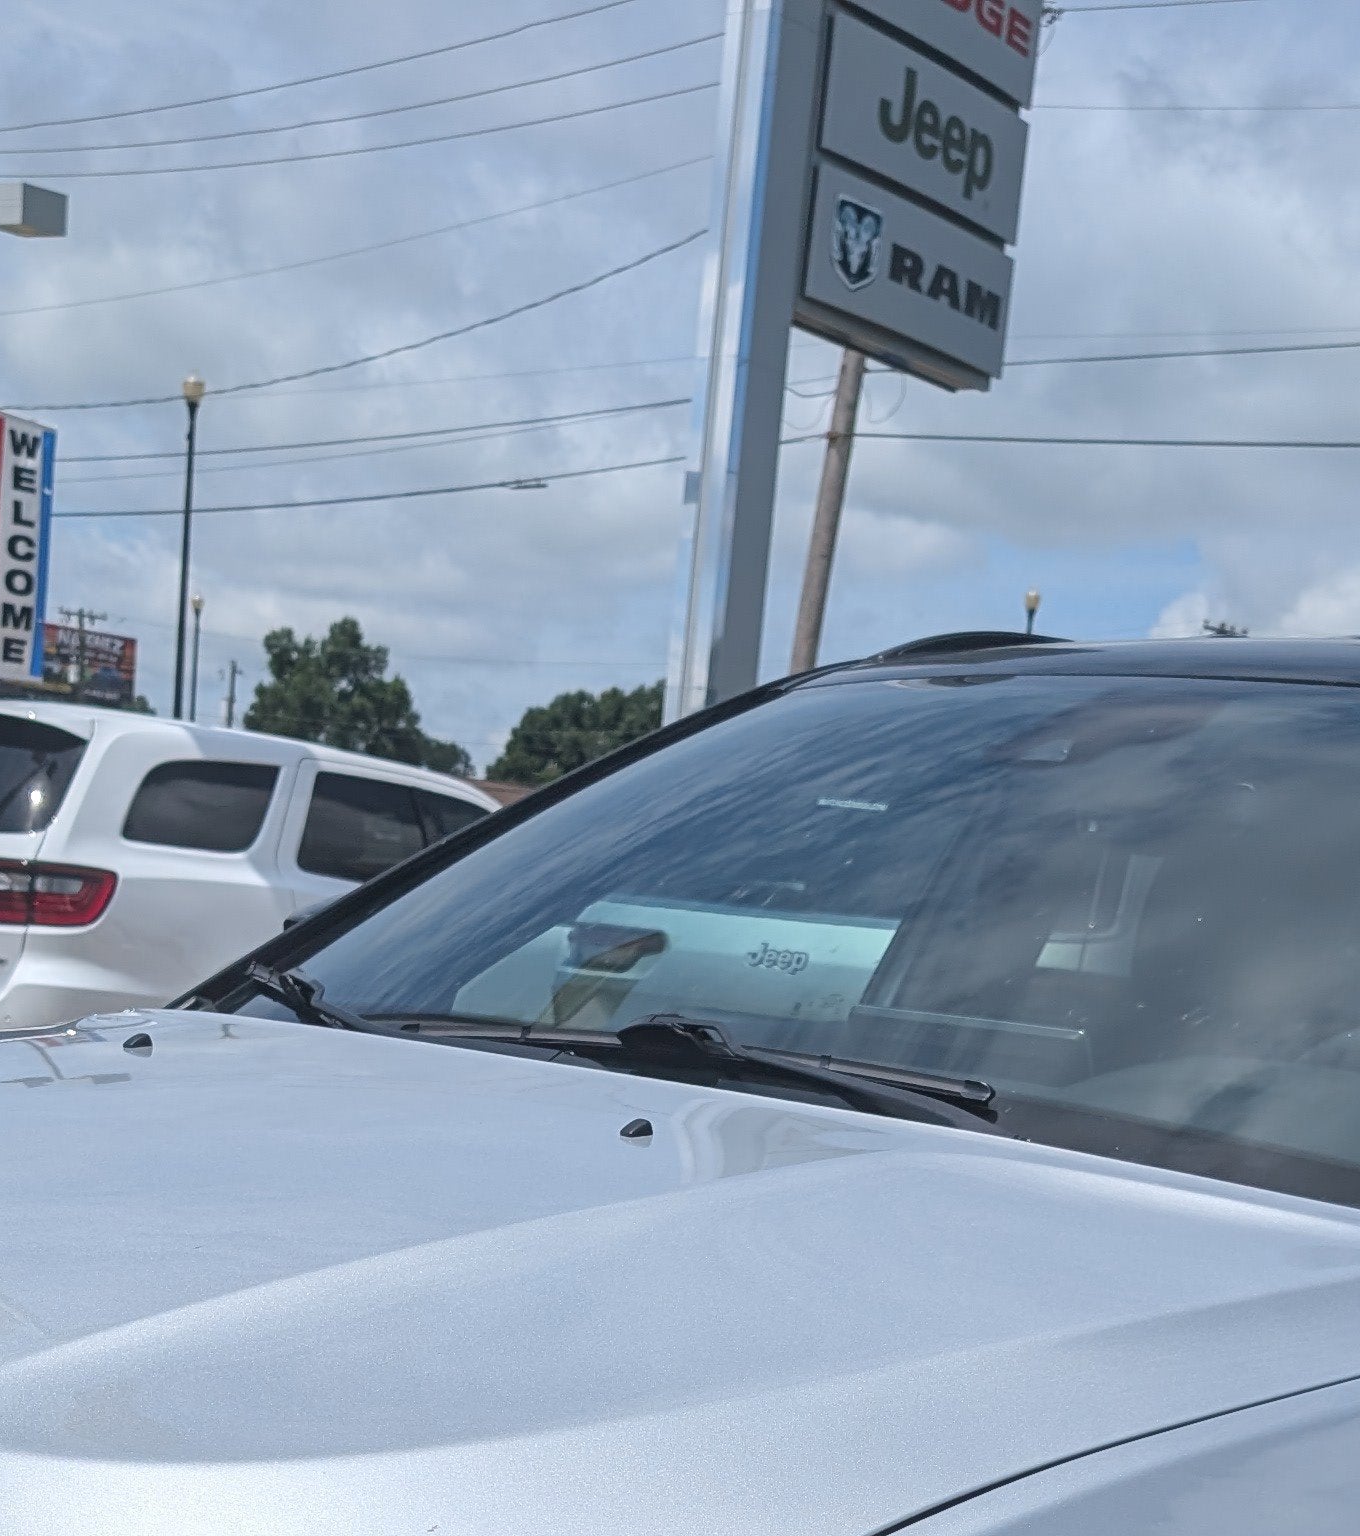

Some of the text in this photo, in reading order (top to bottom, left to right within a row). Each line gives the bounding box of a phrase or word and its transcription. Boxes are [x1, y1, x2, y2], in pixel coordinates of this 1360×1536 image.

[878, 66, 994, 200] Jeep
[887, 243, 1001, 331] RAM
[2, 429, 42, 664] WELCOME
[746, 942, 809, 975] Jeep
